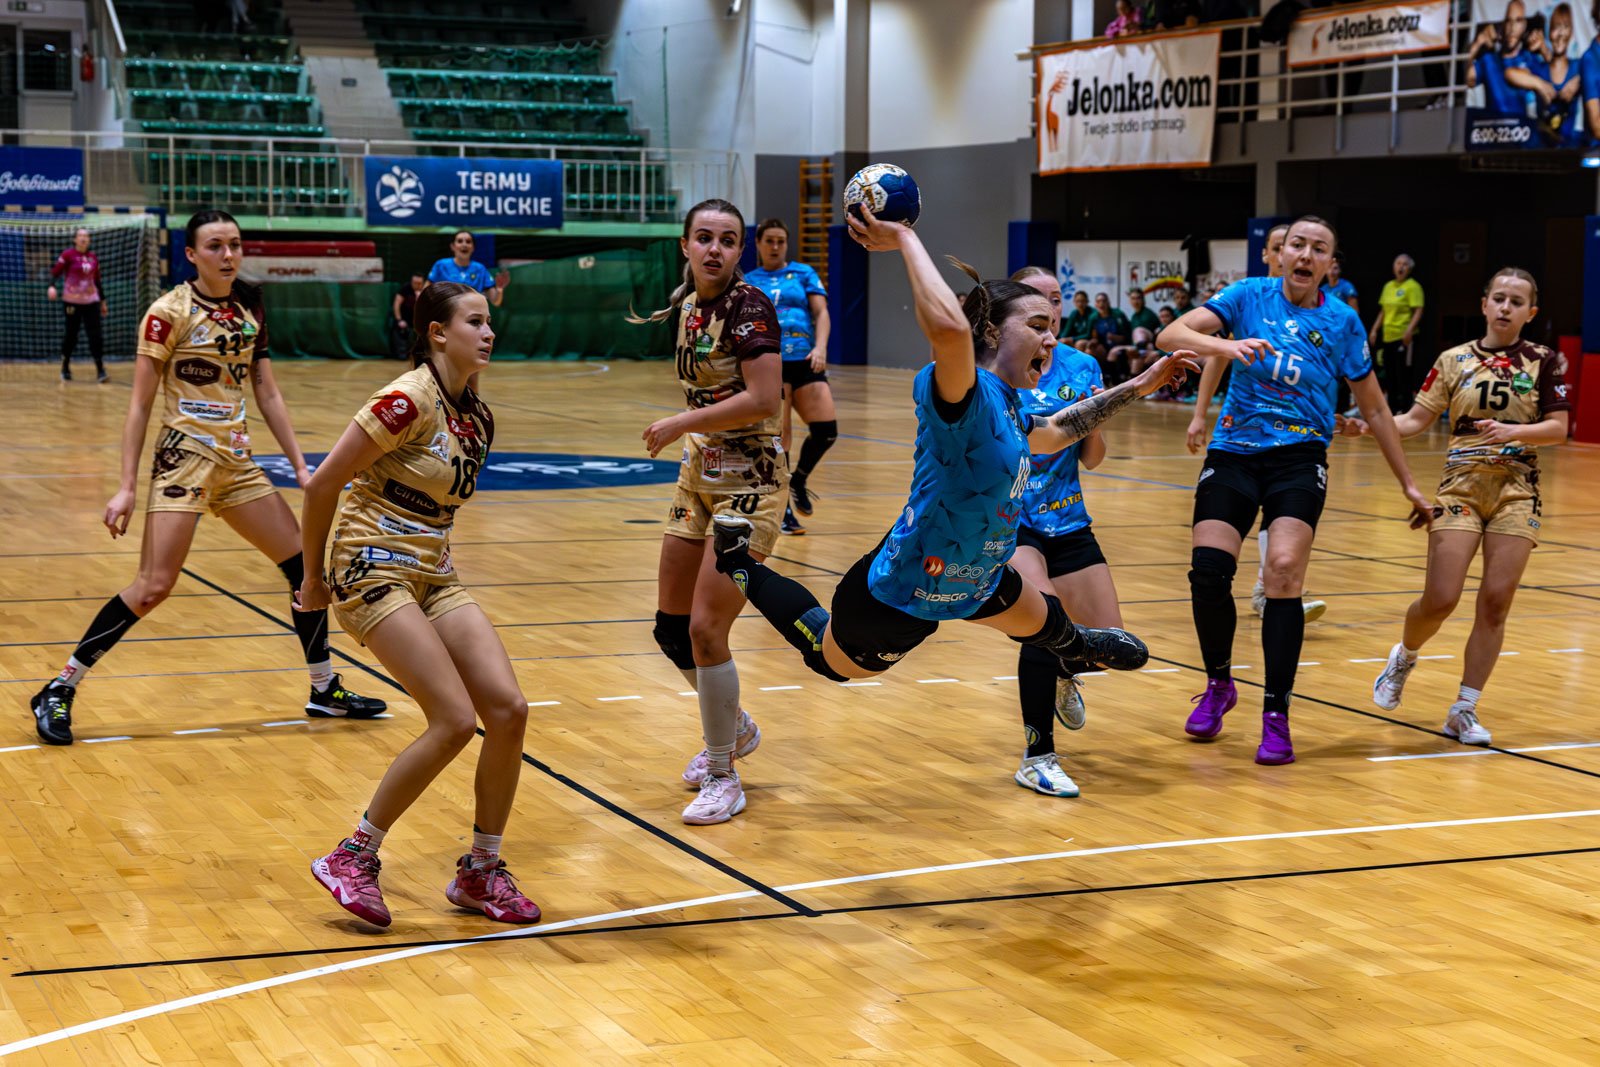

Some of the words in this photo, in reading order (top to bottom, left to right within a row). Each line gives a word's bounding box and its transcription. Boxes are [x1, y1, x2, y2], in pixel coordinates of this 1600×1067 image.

[1328, 14, 1421, 42] Jelonka.com
[1068, 73, 1212, 116] Jelonka.com
[1470, 126, 1531, 143] 6:00-22:00
[457, 170, 531, 191] TERMY
[434, 195, 552, 216] CIEPLICKIE
[1144, 260, 1184, 280] JELENIA
[770, 288, 781, 306] 7
[181, 363, 214, 377] elmas
[676, 345, 697, 381] 10
[1270, 350, 1304, 386] 15
[1475, 380, 1509, 411] 15
[448, 455, 478, 500] 18
[730, 494, 760, 514] 10
[944, 563, 985, 579] eco
